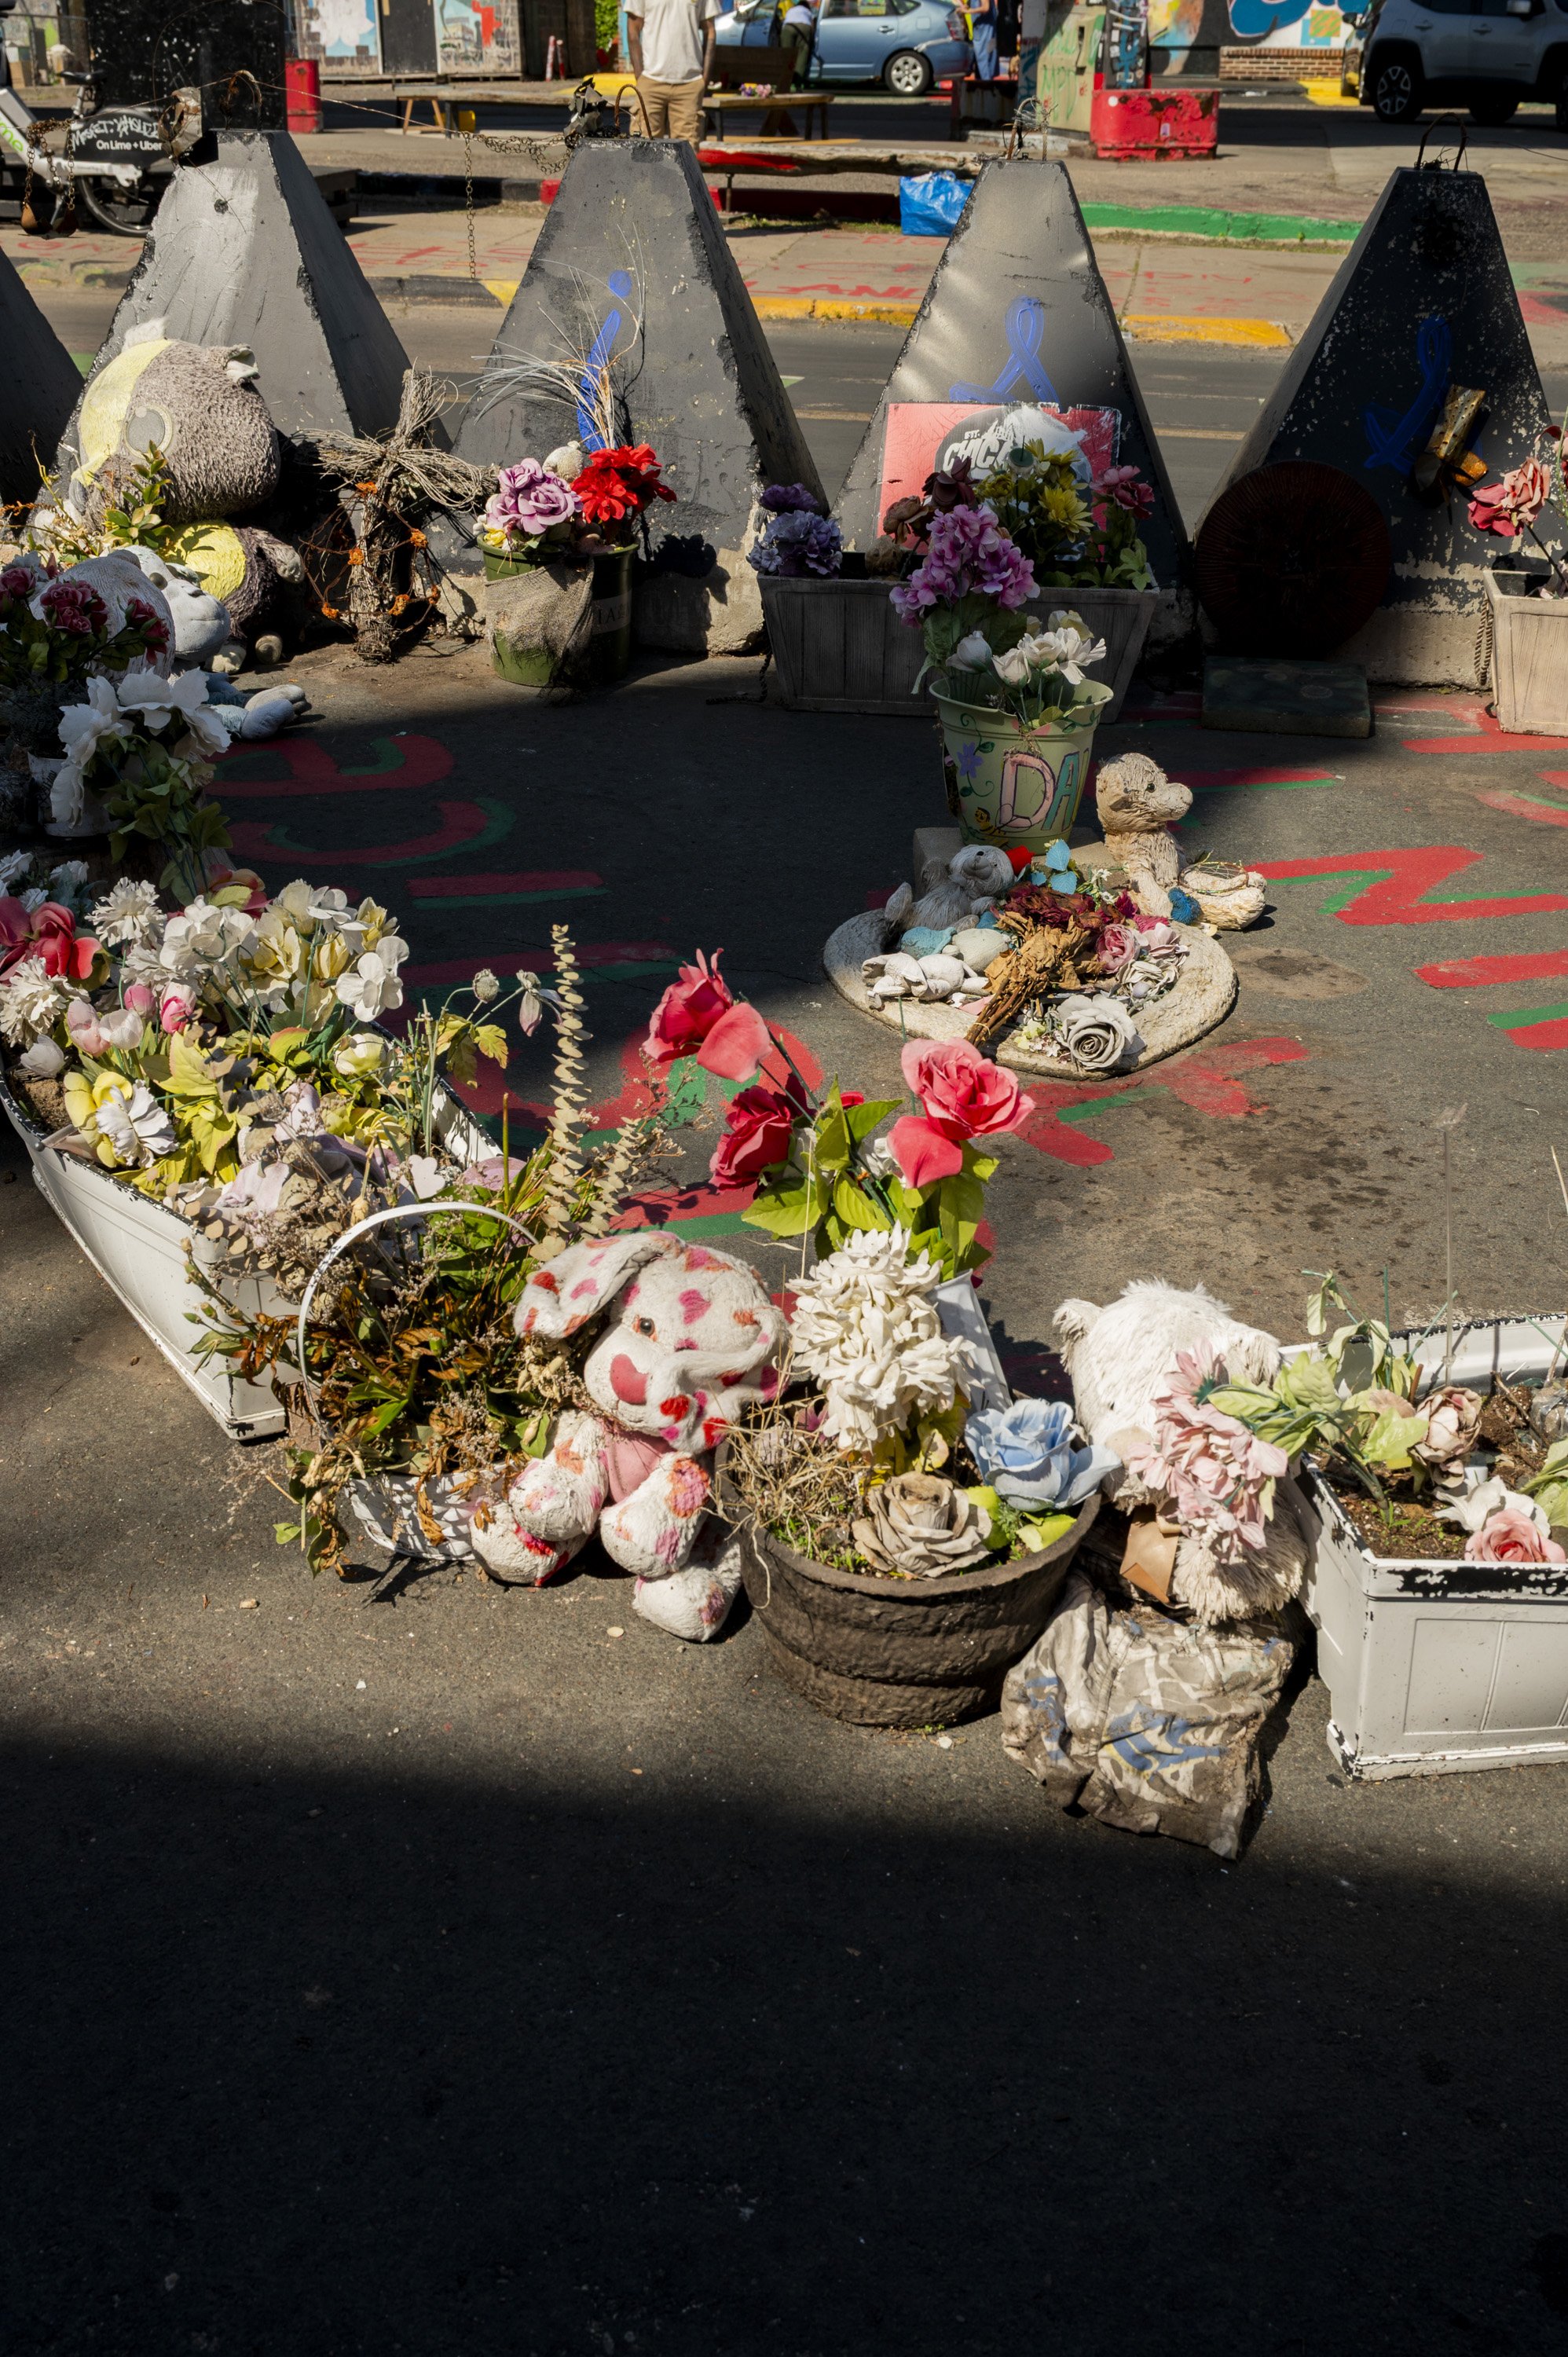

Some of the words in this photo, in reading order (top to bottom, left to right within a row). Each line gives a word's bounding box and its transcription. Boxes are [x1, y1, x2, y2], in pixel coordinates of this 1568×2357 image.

[96, 140, 110, 150] On
[110, 140, 132, 150] Lime
[139, 140, 162, 150] Uber
